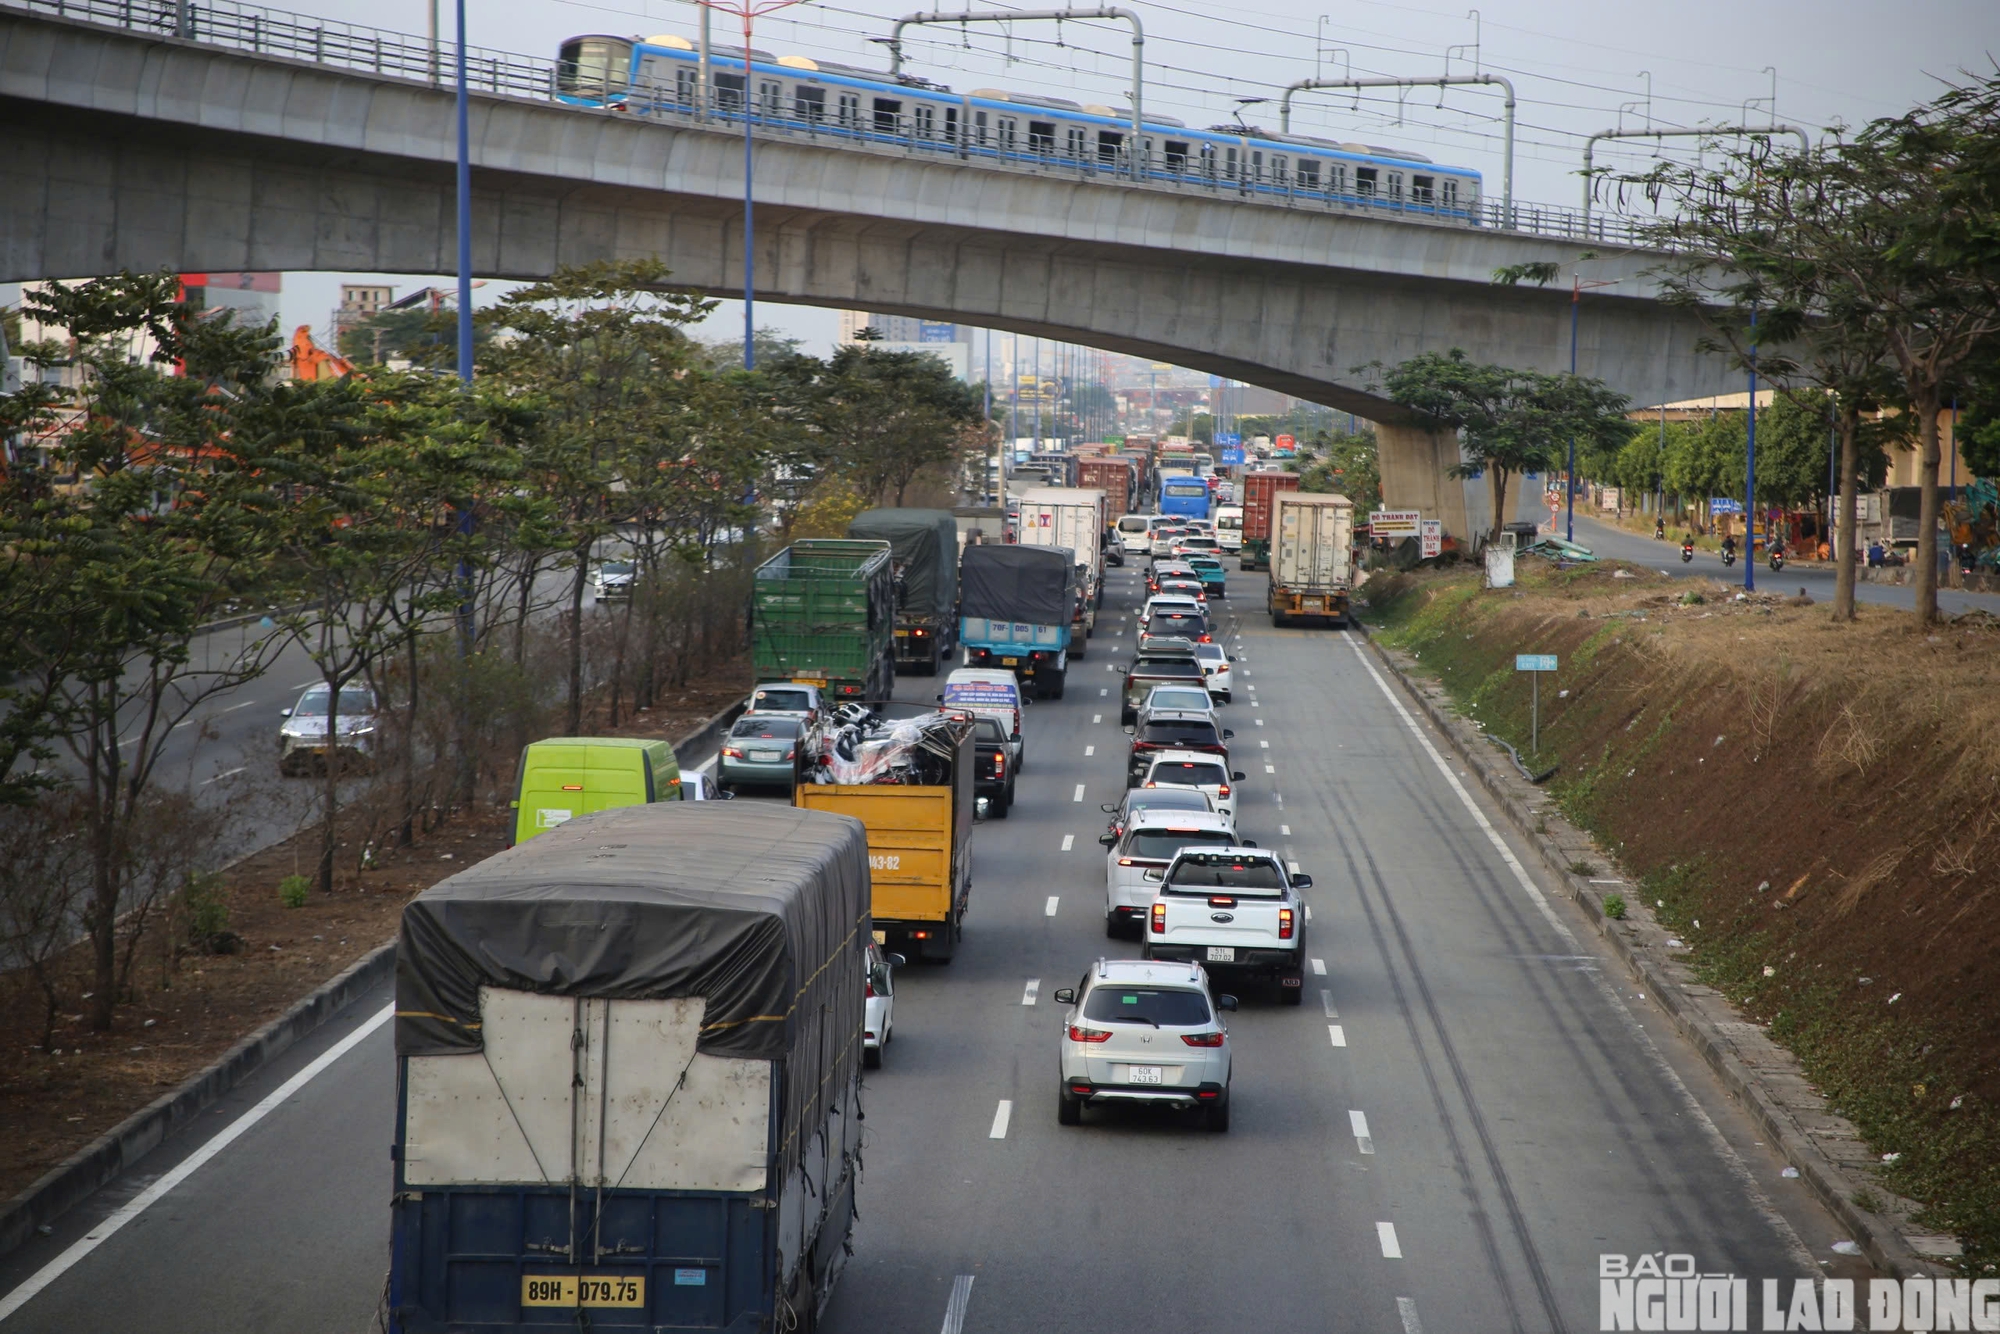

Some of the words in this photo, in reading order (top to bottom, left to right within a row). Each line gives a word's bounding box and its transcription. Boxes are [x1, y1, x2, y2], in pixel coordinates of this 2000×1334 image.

[1138, 1067, 1152, 1075] 60K
[1132, 1075, 1159, 1083] 743.63
[529, 1281, 561, 1300] 89H
[580, 1282, 637, 1301] 079.75
